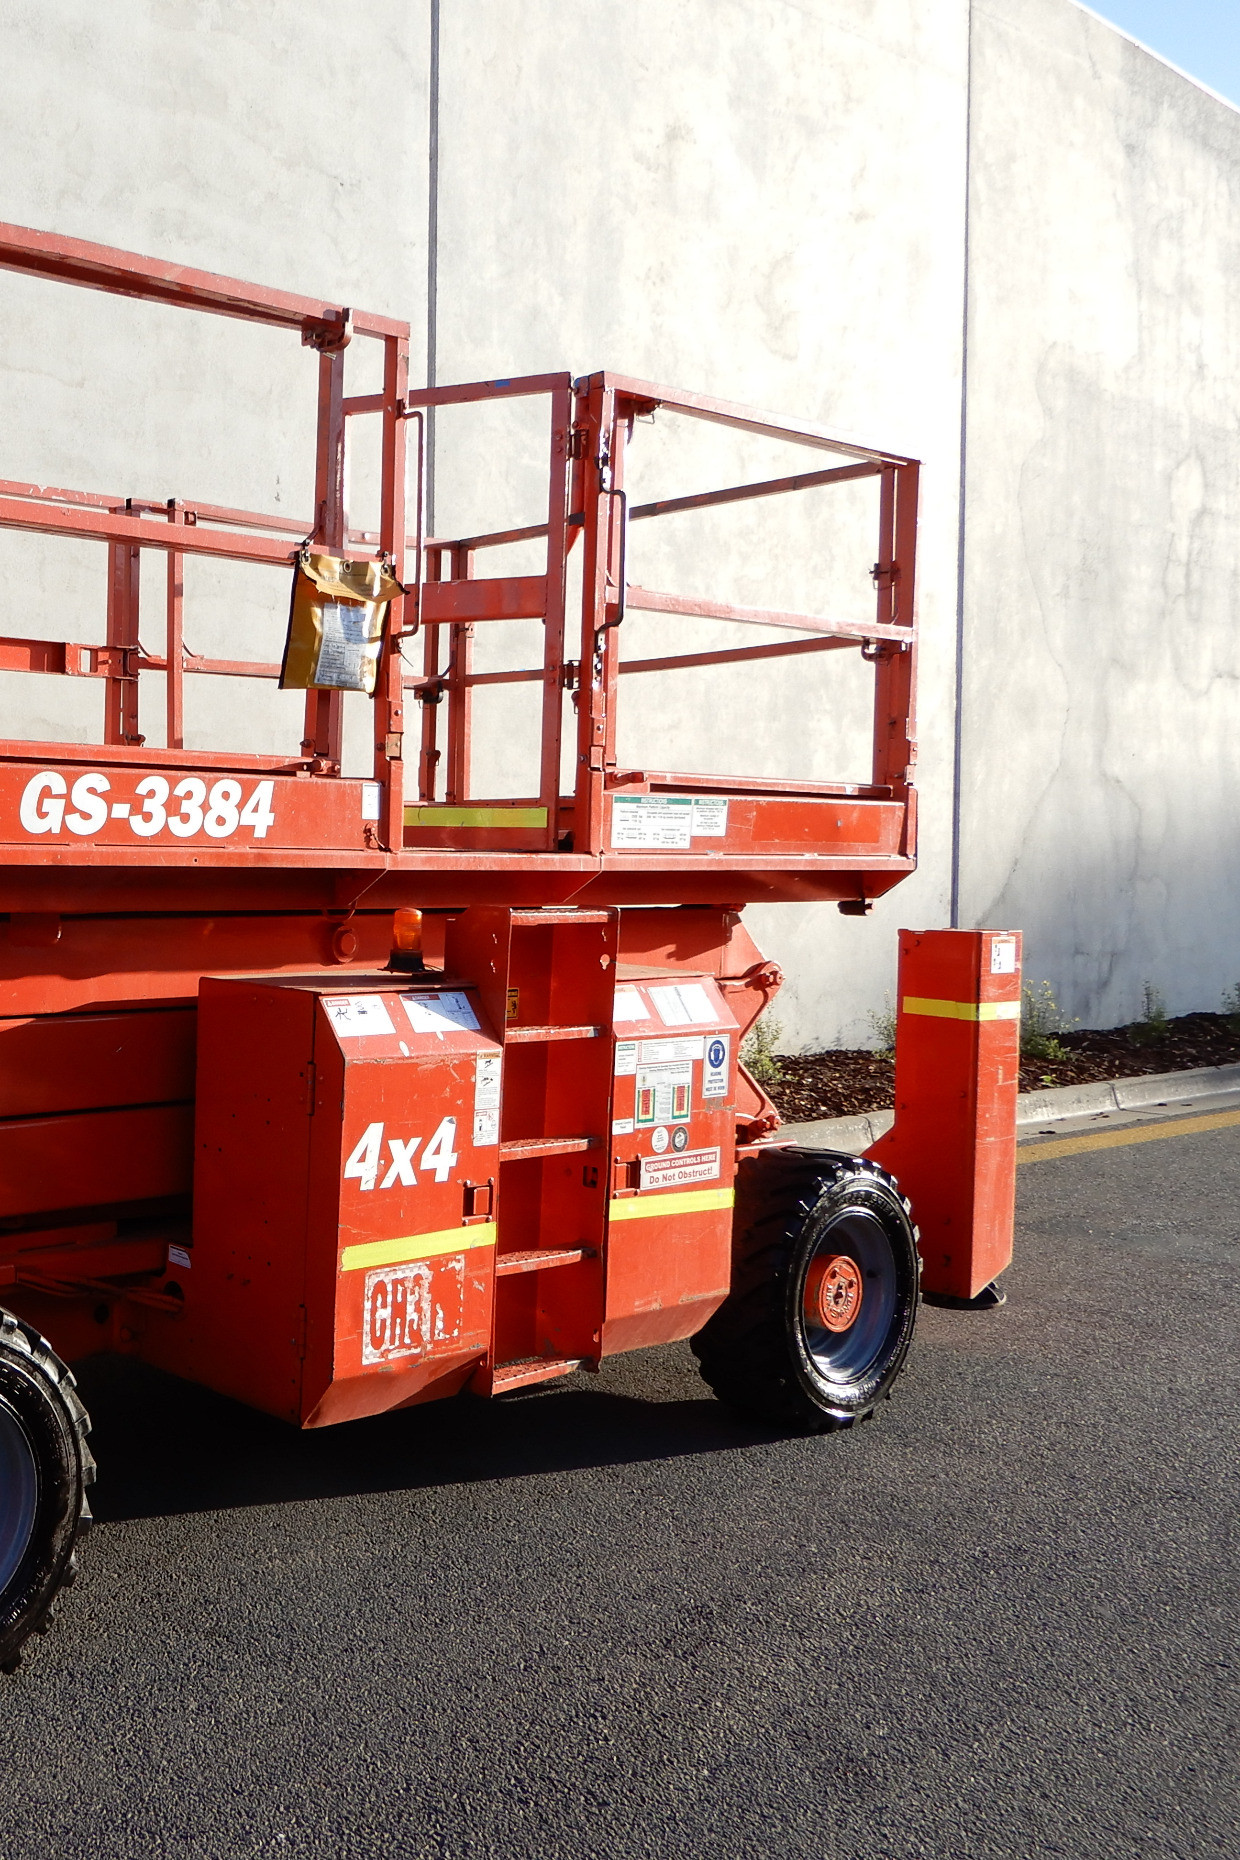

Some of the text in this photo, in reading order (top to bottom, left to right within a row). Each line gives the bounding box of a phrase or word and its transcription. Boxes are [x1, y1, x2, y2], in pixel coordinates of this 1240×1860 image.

[19, 770, 276, 838] GS-3384
[343, 1116, 458, 1191] 4x4
[645, 1153, 717, 1171] GROUND CONTROLS HERE
[649, 1166, 713, 1184] Do Not Obstruct!
